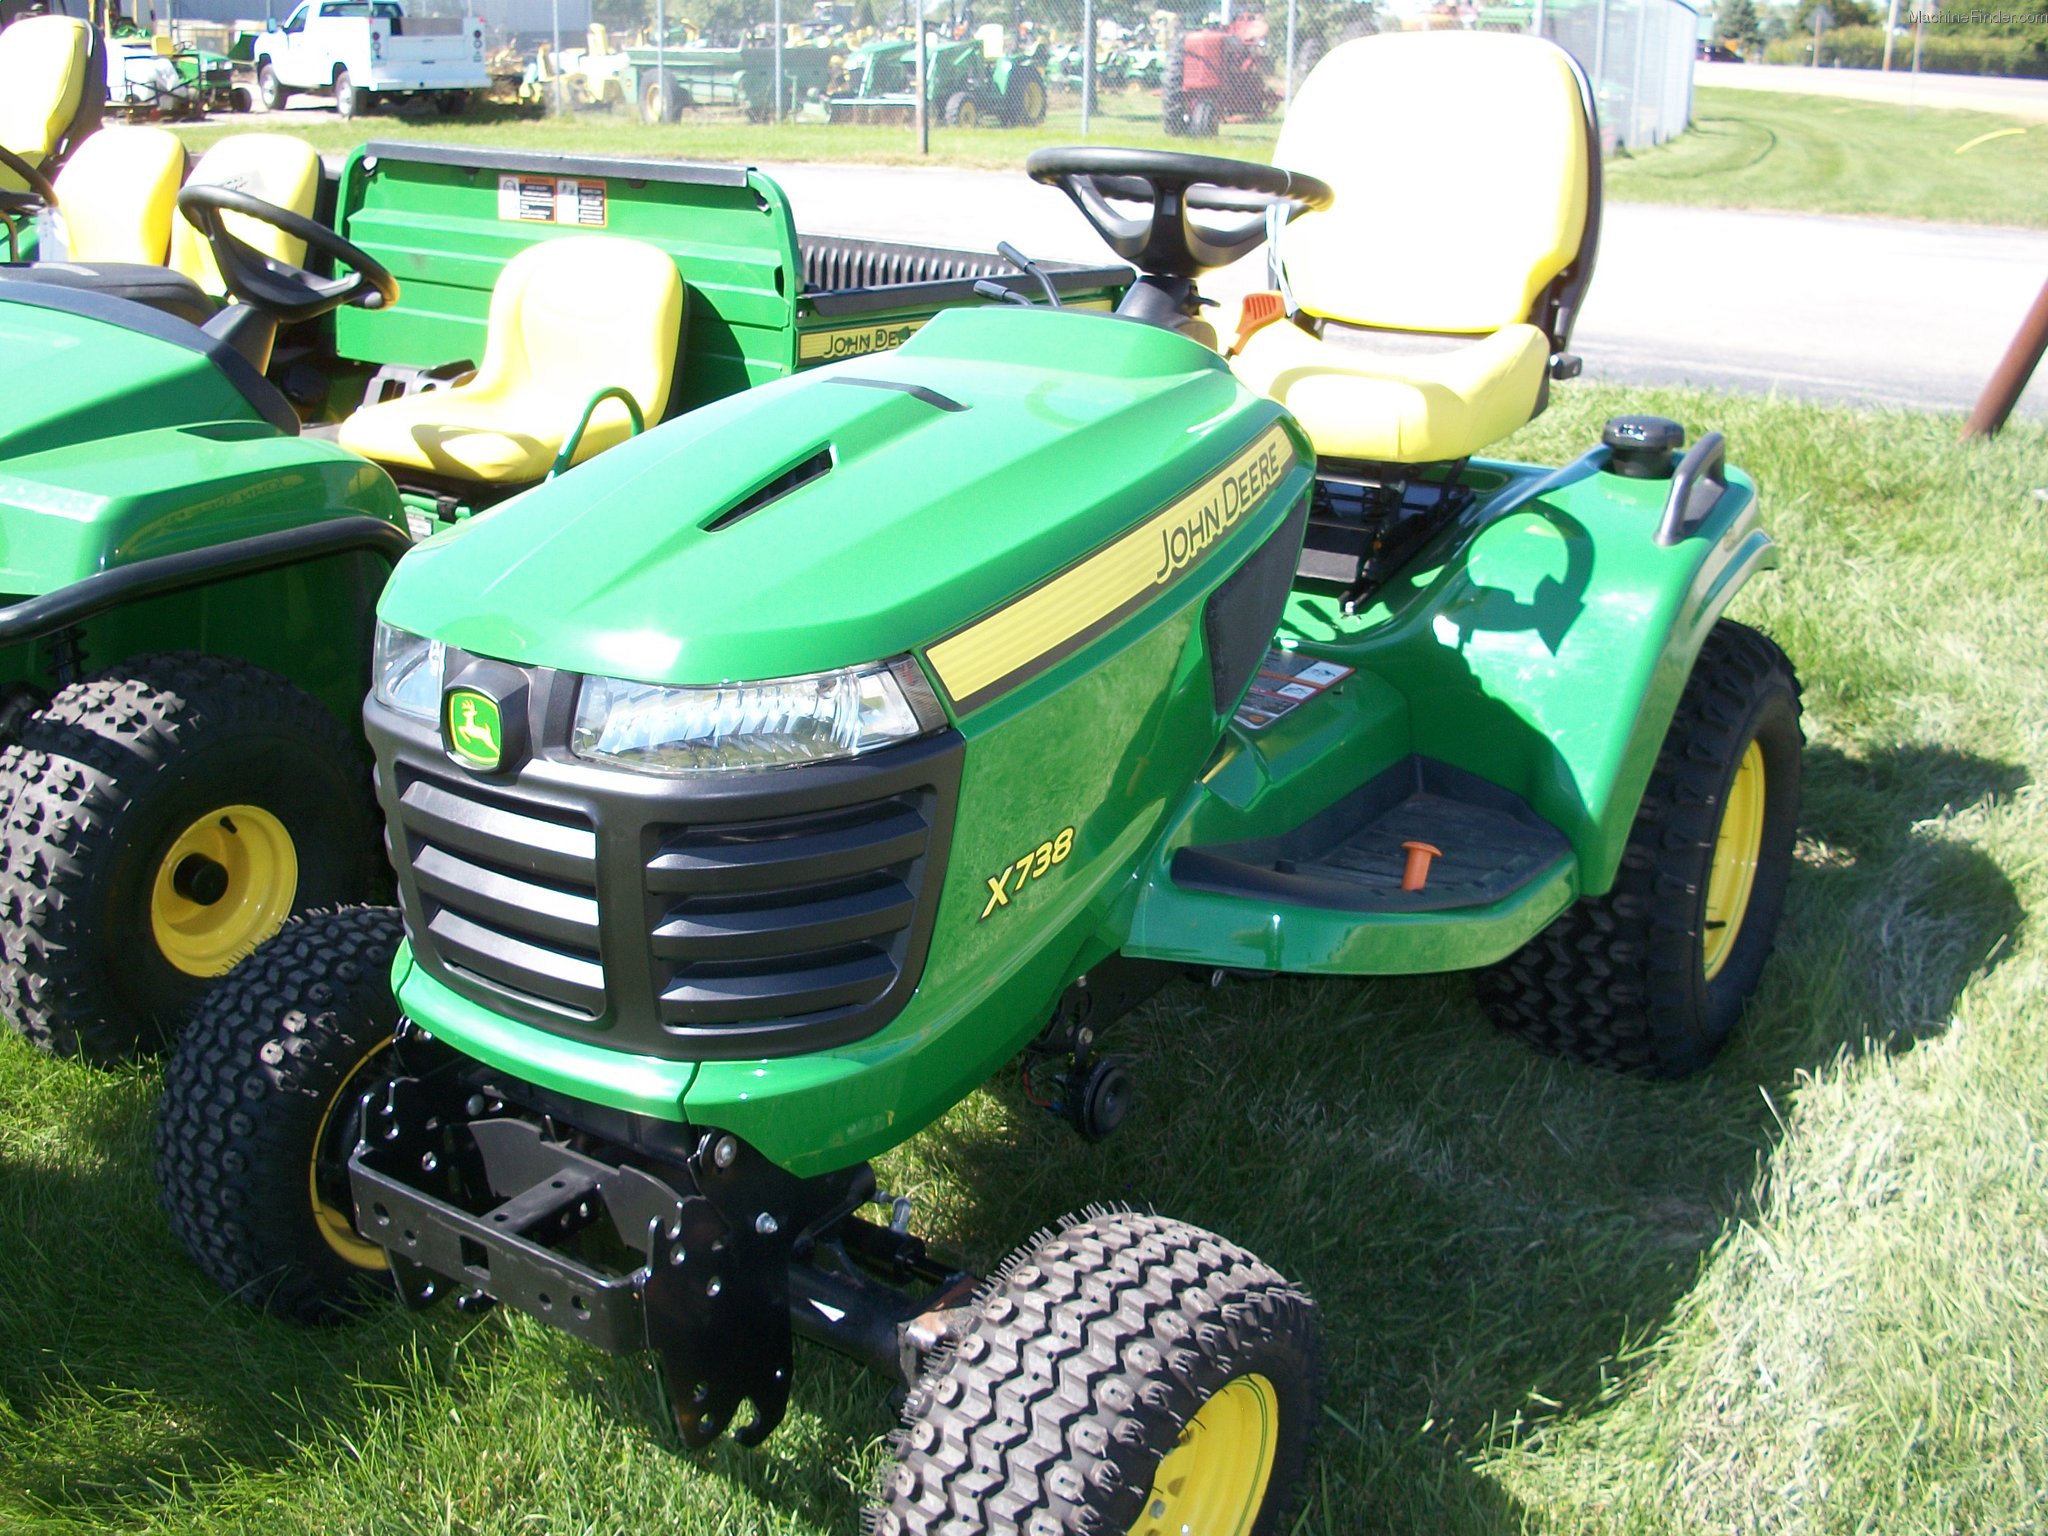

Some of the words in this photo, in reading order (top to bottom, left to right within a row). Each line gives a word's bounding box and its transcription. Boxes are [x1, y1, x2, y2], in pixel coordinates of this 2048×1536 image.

[823, 334, 871, 356] JOHN
[1156, 497, 1220, 579] JOHN
[1222, 441, 1280, 523] DEERE
[978, 825, 1075, 922] X738
